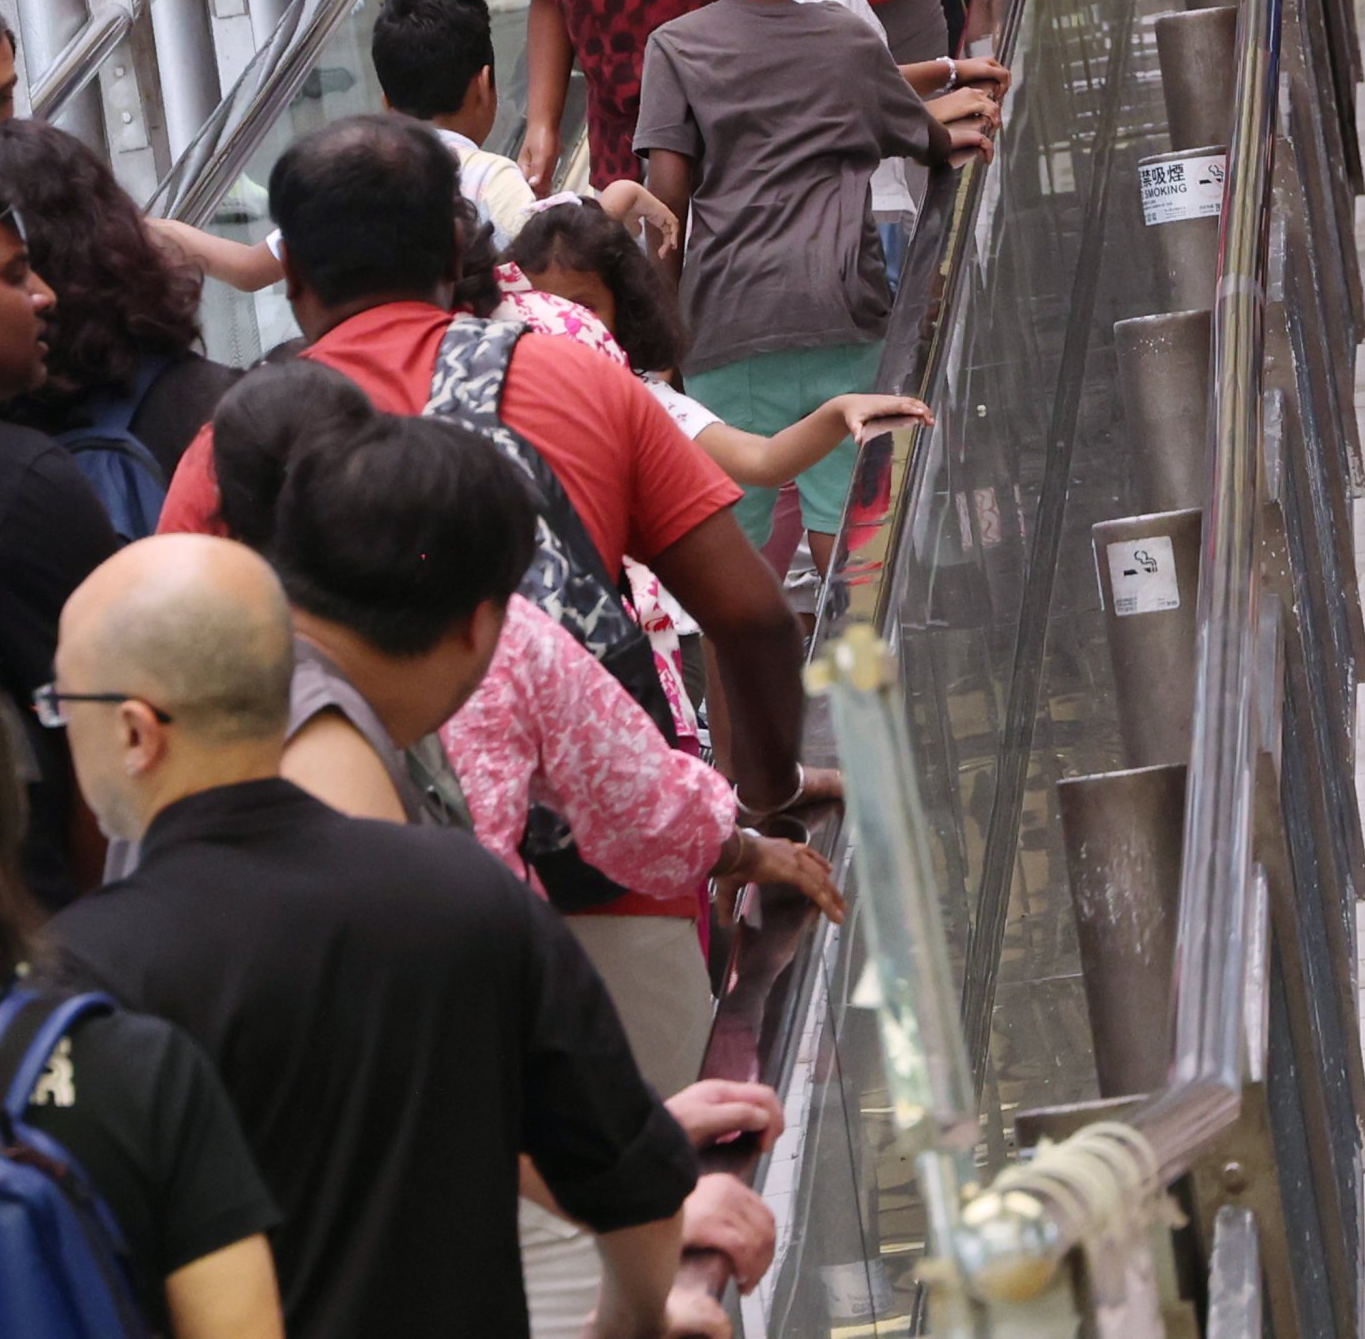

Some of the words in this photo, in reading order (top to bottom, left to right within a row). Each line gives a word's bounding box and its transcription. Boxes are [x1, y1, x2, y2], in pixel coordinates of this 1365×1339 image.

[1139, 163, 1186, 188] 禁吸煙
[1144, 183, 1188, 200] SMOKING
